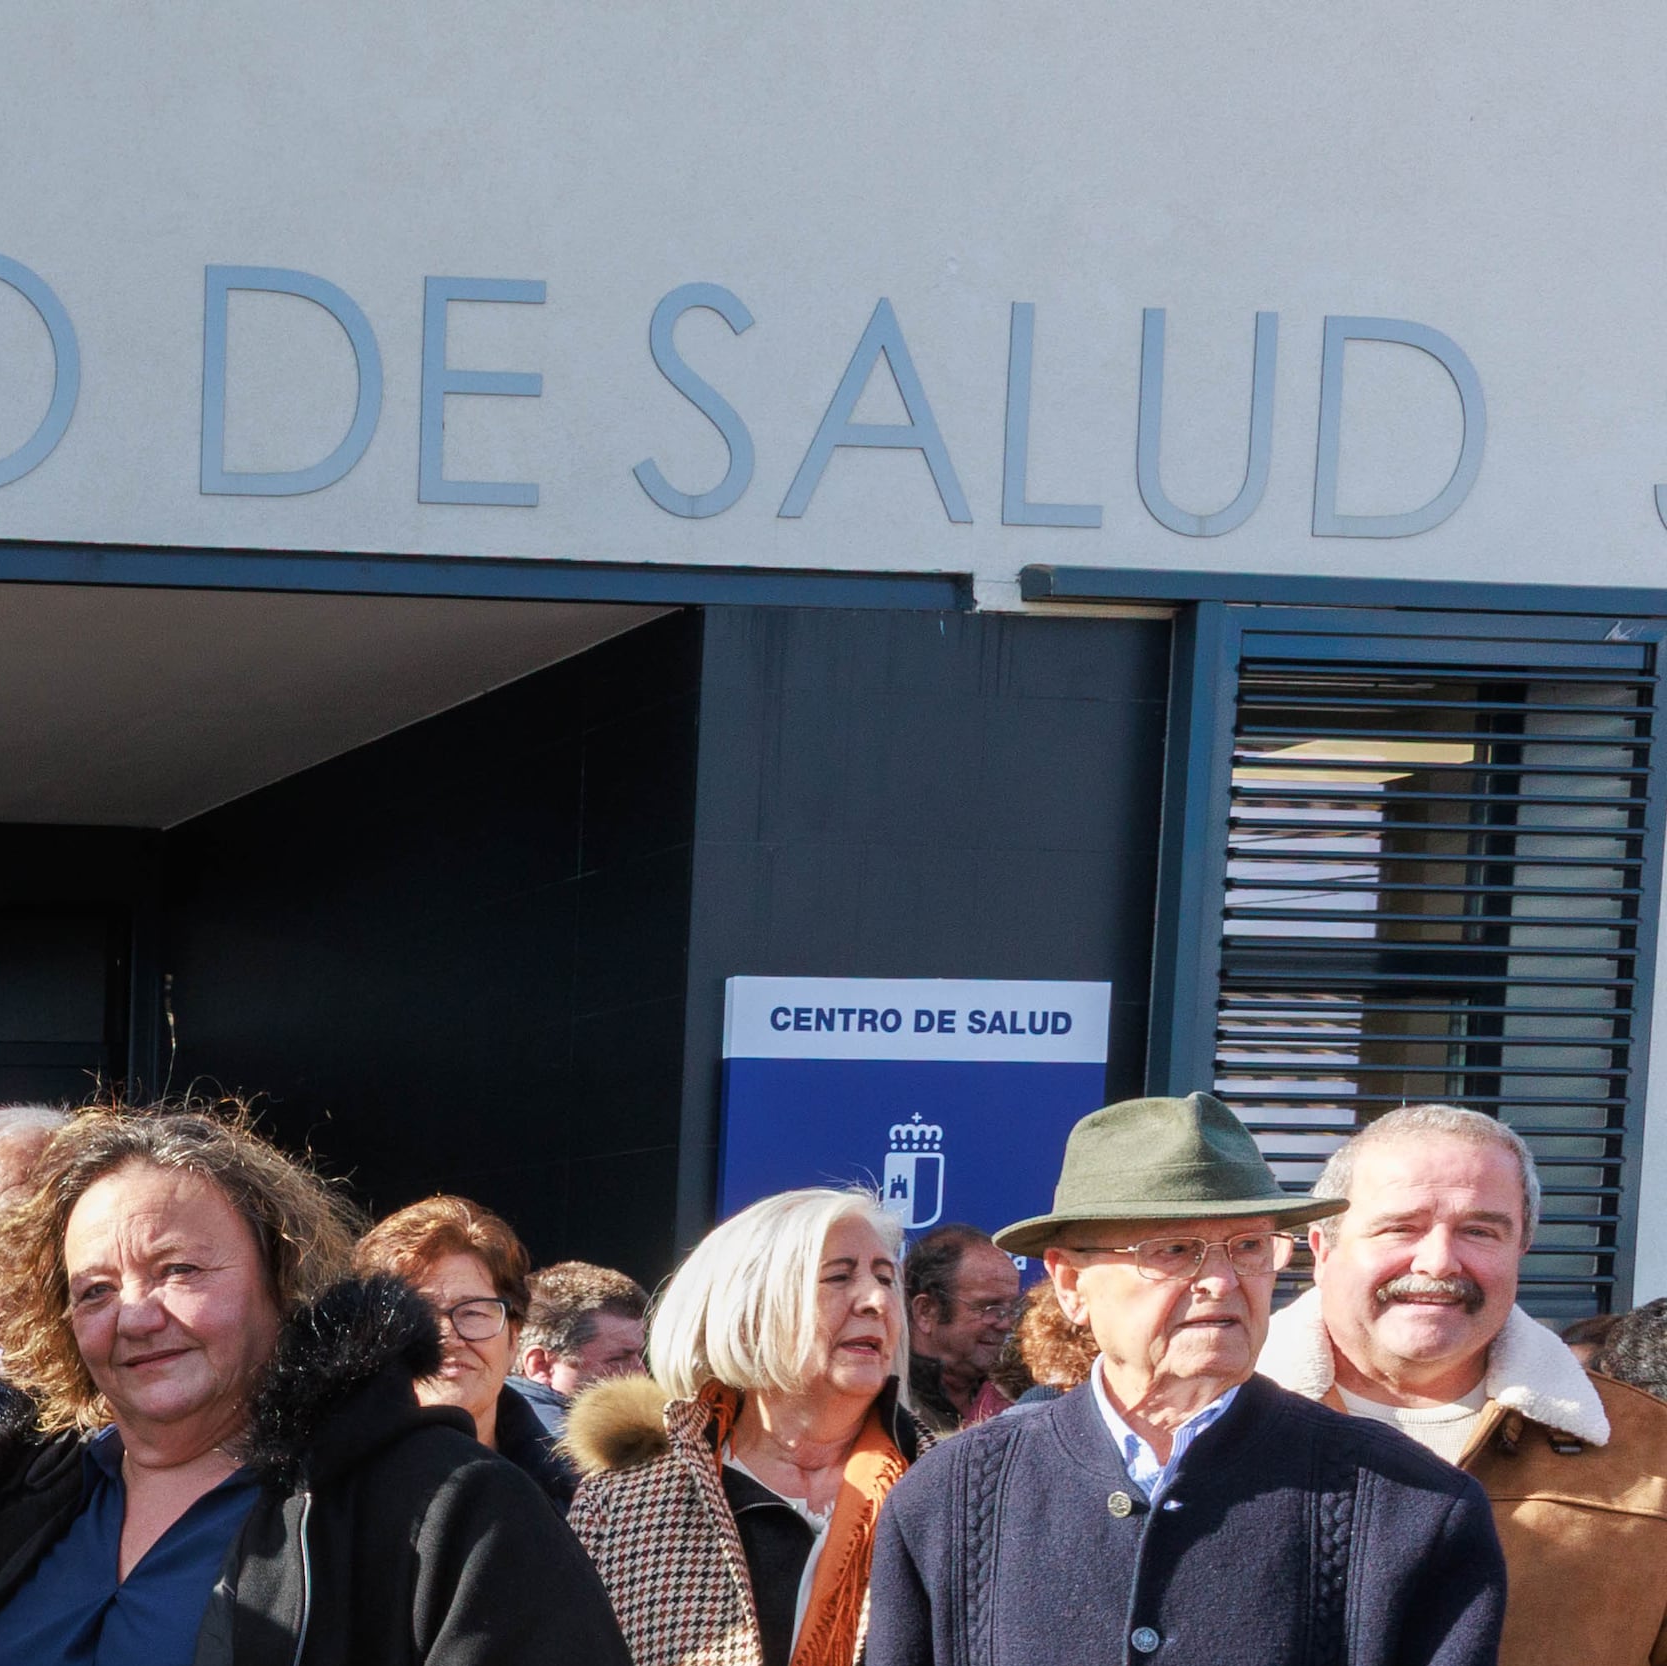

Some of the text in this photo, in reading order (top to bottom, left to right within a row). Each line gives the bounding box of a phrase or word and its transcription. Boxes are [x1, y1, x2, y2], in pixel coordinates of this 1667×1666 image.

[199, 264, 547, 508] DE
[631, 280, 1488, 540] SALUD
[770, 1006, 1072, 1035] CENTRO DE SALUD
